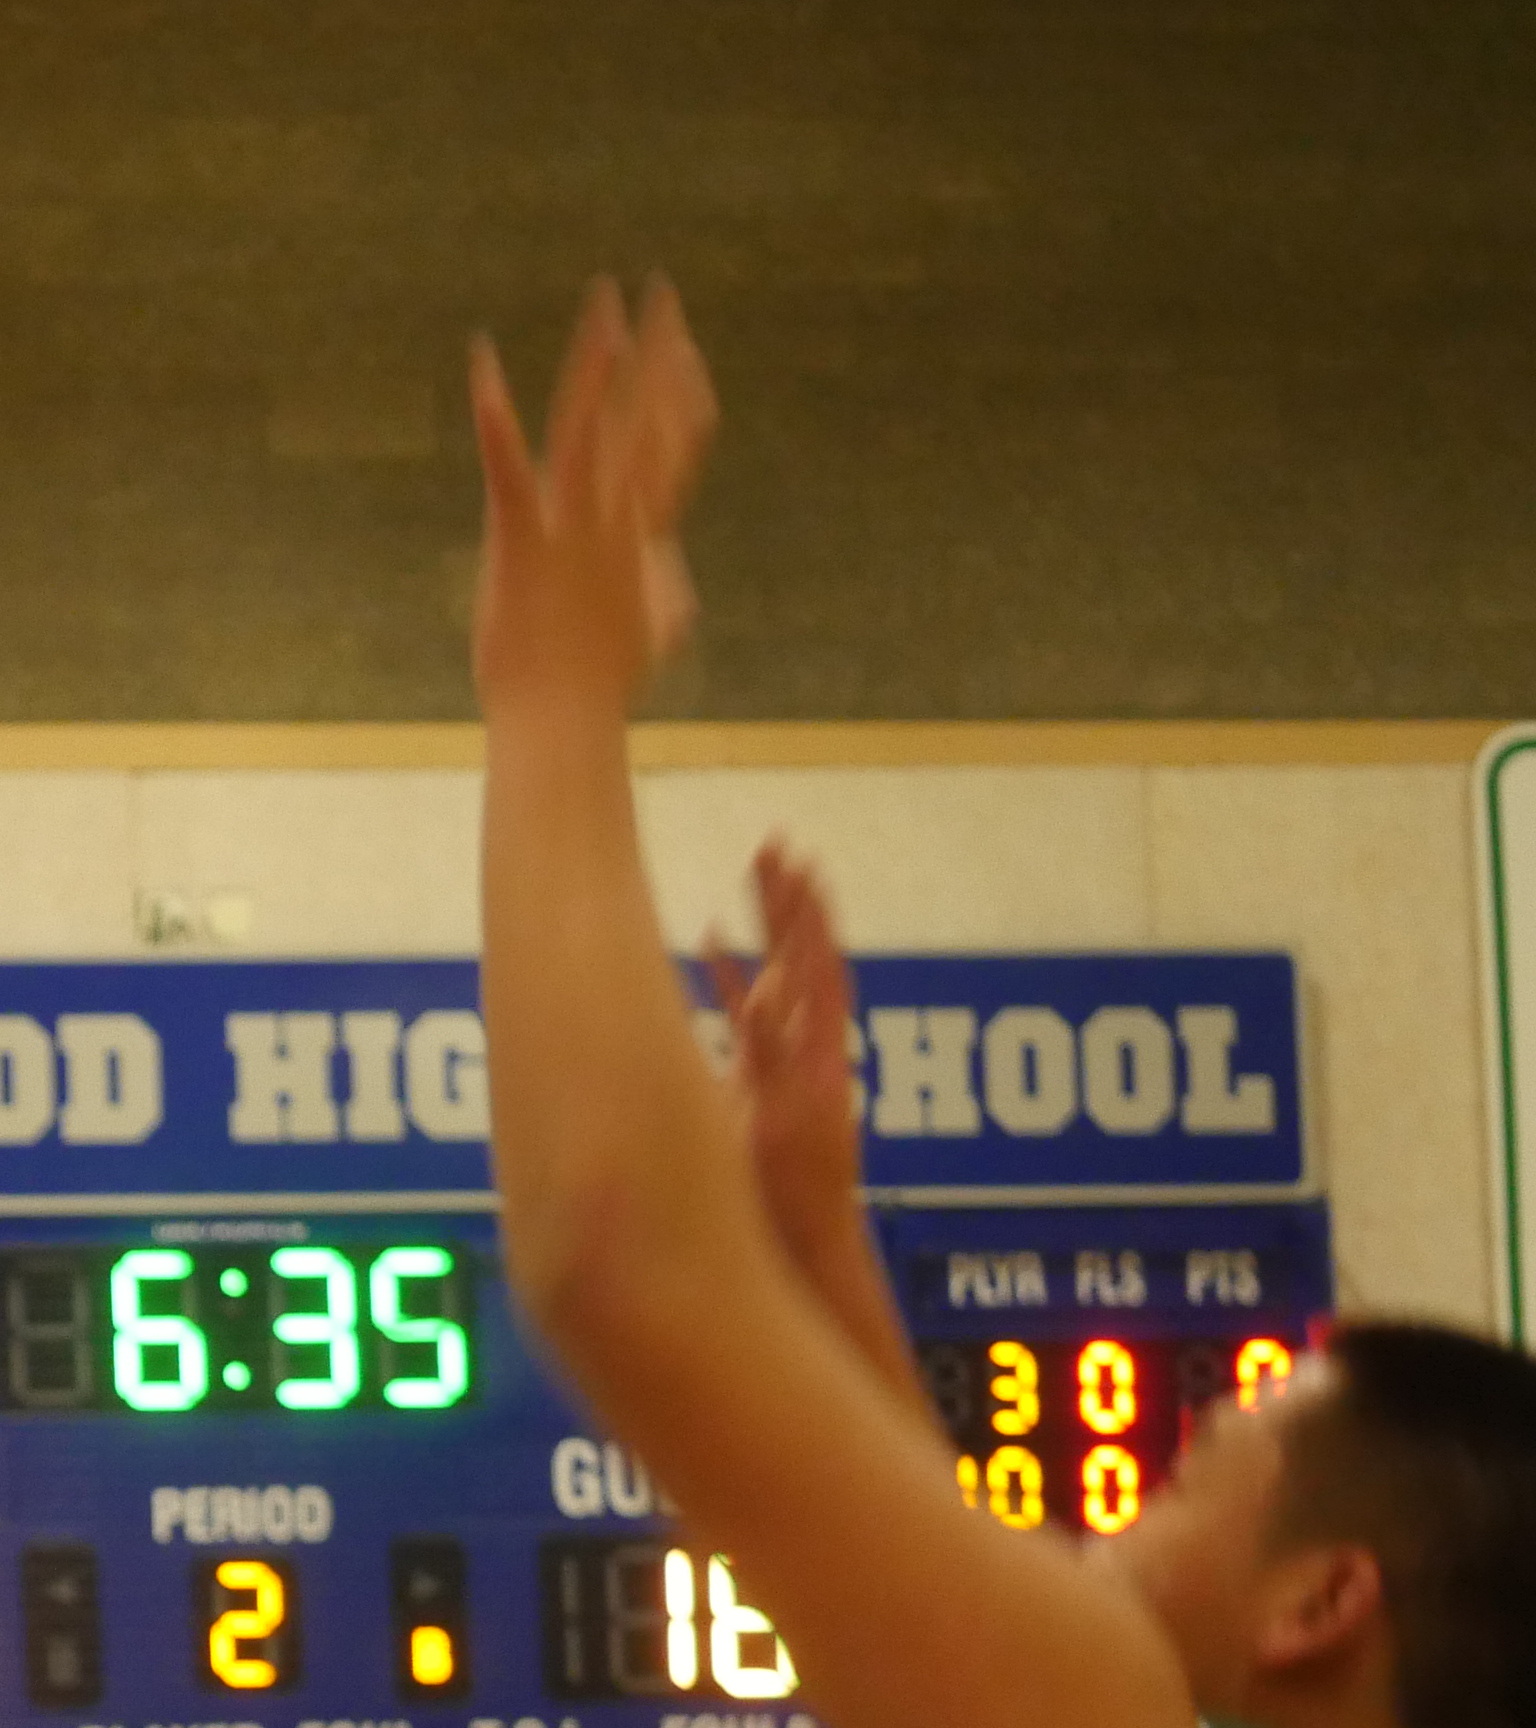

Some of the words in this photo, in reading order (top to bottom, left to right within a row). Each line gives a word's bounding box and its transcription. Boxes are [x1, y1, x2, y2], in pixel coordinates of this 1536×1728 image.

[224, 1008, 495, 1143] HIG
[690, 1005, 1276, 1140] HOOL
[110, 1248, 469, 1411] 6:35
[988, 1340, 1040, 1436] 3
[1077, 1339, 1136, 1435] 0
[150, 1484, 333, 1546] PERIOD
[1081, 1444, 1140, 1535] 0
[209, 1560, 286, 1689] 2
